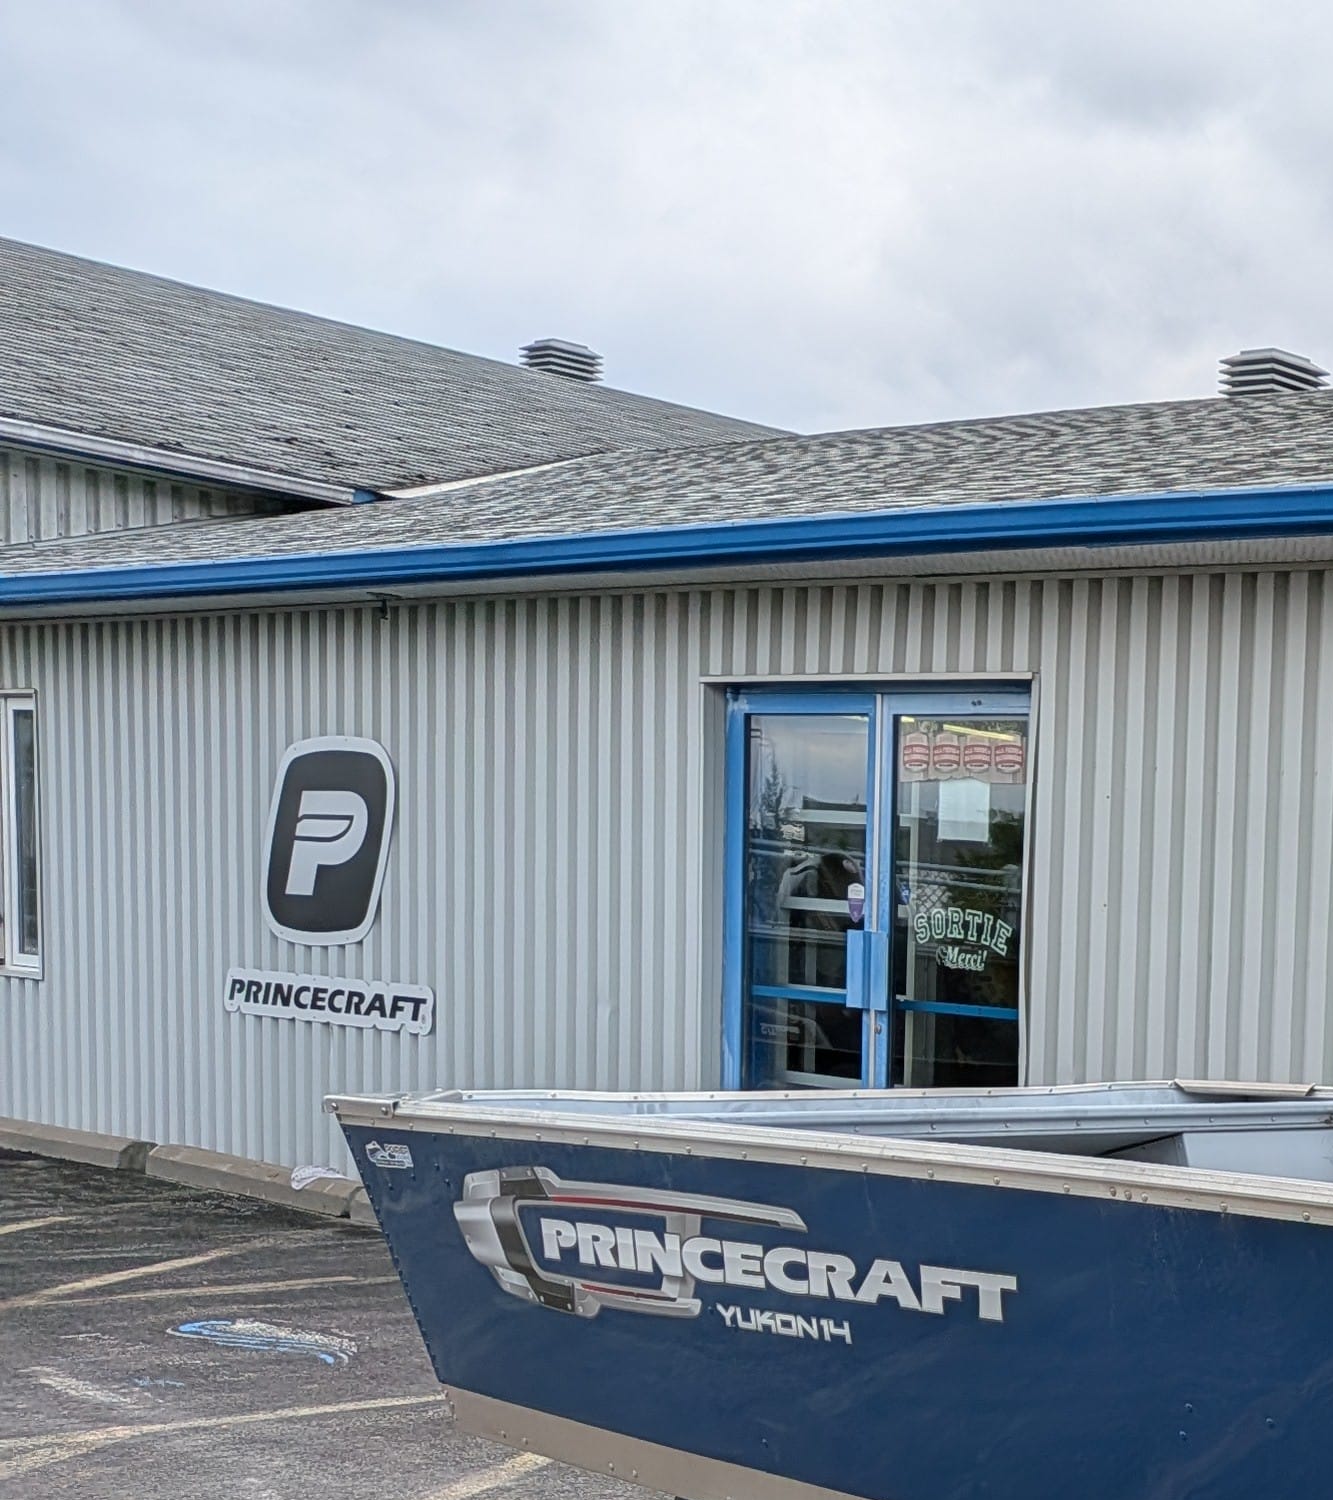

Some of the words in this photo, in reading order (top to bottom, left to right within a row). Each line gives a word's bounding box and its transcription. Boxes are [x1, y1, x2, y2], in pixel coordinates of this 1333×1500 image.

[914, 907, 1013, 957] SORTIE
[946, 946, 988, 971] Merci!
[229, 978, 427, 1021] PRINCECRAFT
[539, 1216, 1018, 1322] PRINCECRAFT
